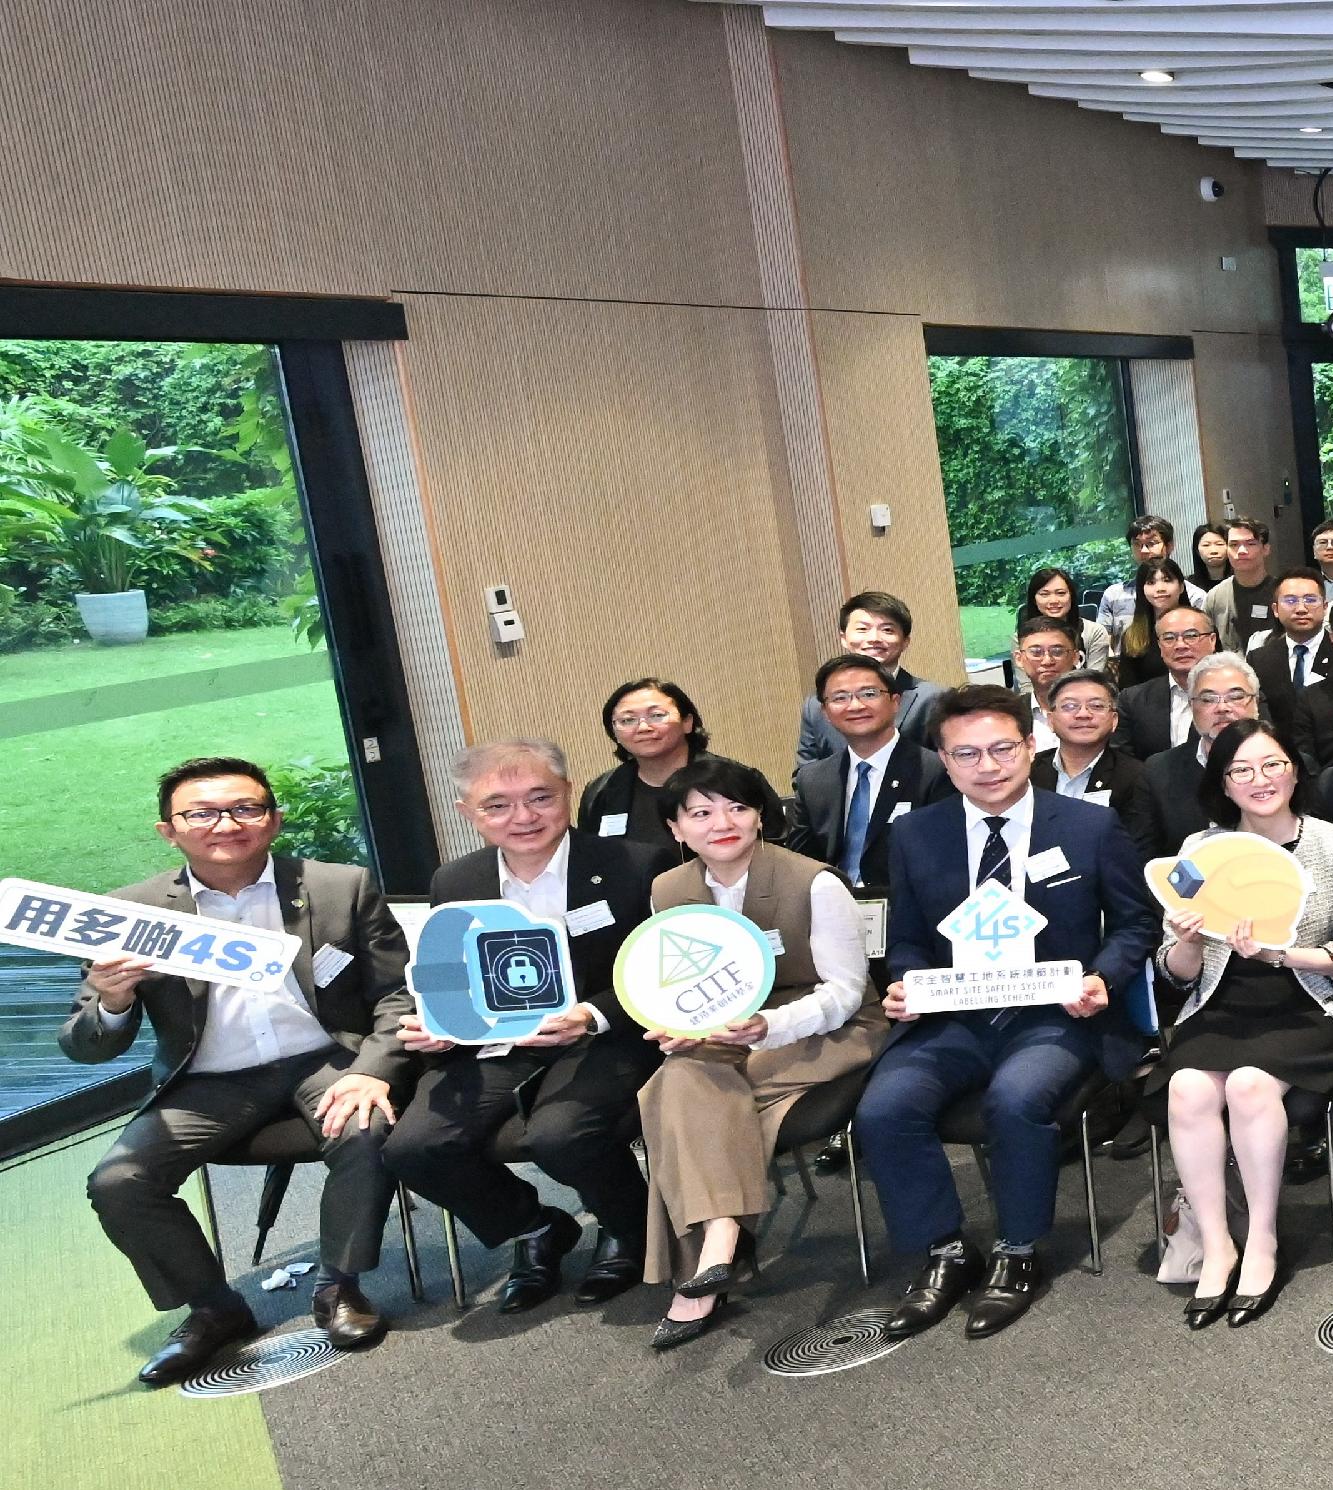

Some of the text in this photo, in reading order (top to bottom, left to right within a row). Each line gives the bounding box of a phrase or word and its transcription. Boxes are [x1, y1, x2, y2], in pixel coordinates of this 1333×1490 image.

[675, 960, 741, 1014] CITF
[930, 981, 1055, 997] SMART SITE SAFETY SYSTEM
[953, 993, 1036, 1007] LABELLING SCHEME
